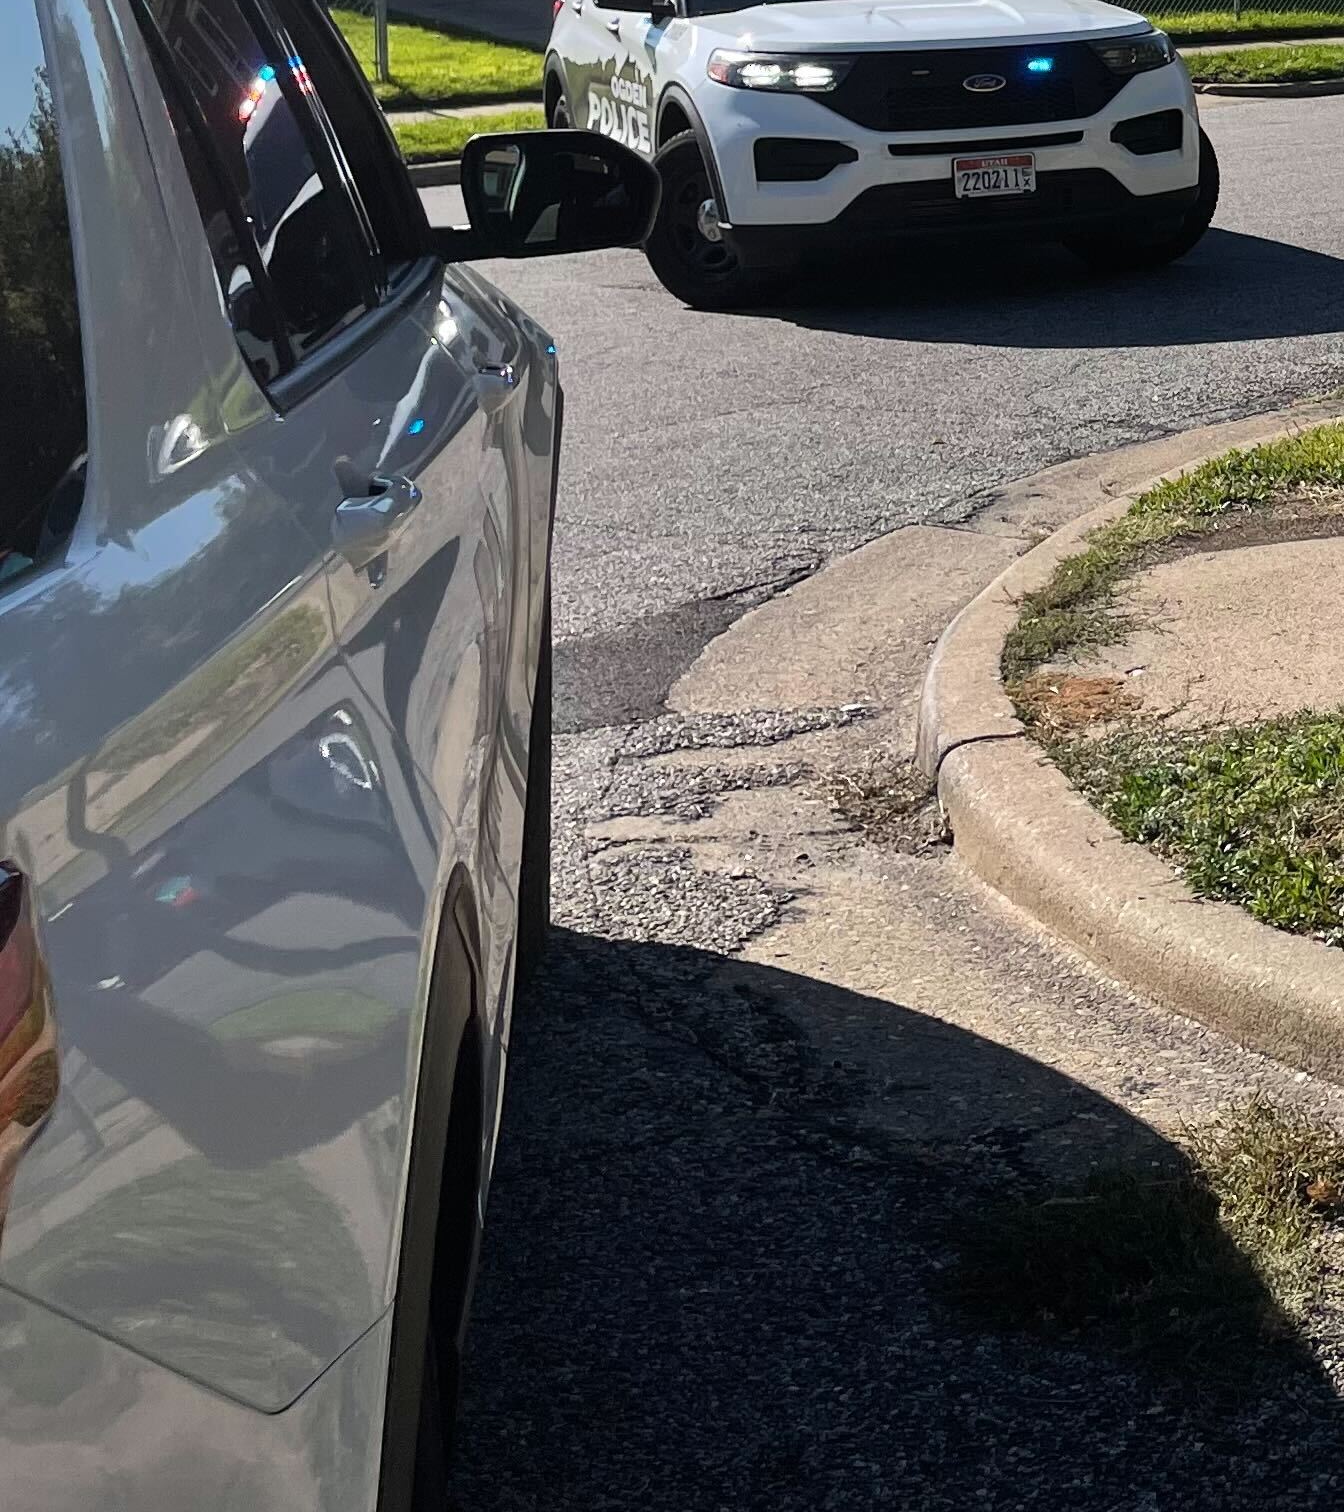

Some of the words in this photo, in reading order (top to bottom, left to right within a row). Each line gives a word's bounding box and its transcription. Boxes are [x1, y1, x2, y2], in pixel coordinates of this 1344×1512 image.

[611, 75, 647, 108] OGDEN
[586, 90, 652, 154] POLICE
[981, 158, 1008, 167] UTAH
[961, 168, 1020, 192] 220211
